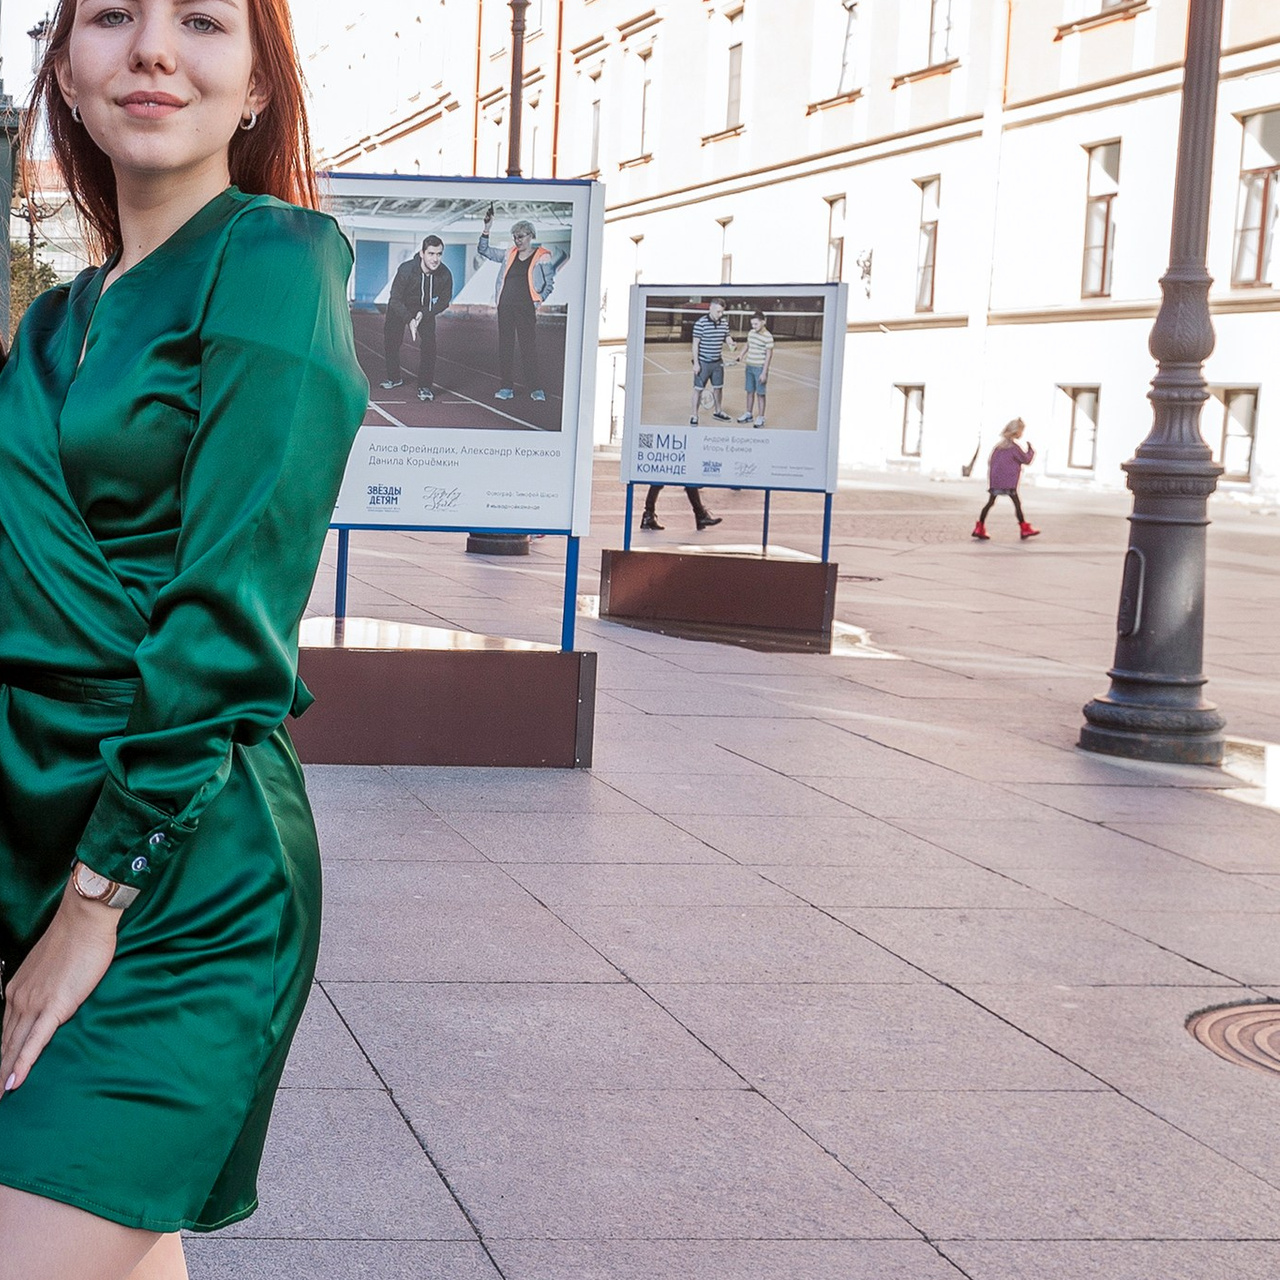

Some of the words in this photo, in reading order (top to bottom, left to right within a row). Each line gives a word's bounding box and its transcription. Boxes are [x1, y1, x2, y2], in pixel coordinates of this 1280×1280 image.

[656, 434, 687, 450] МЫ
[369, 443, 399, 453] Алиса
[400, 444, 458, 455] Фрейндлих,
[460, 446, 512, 457] Александр
[514, 447, 561, 457] Кержаков
[368, 456, 404, 467] Данила
[406, 457, 460, 468] Корчёмкин
[637, 452, 644, 460] В
[647, 451, 686, 462] ОДНОЙ
[637, 464, 687, 475] КОМАНДЕ
[367, 484, 402, 495] ЗВЁЗДЫ
[369, 495, 399, 505] ДЕТЯМ
